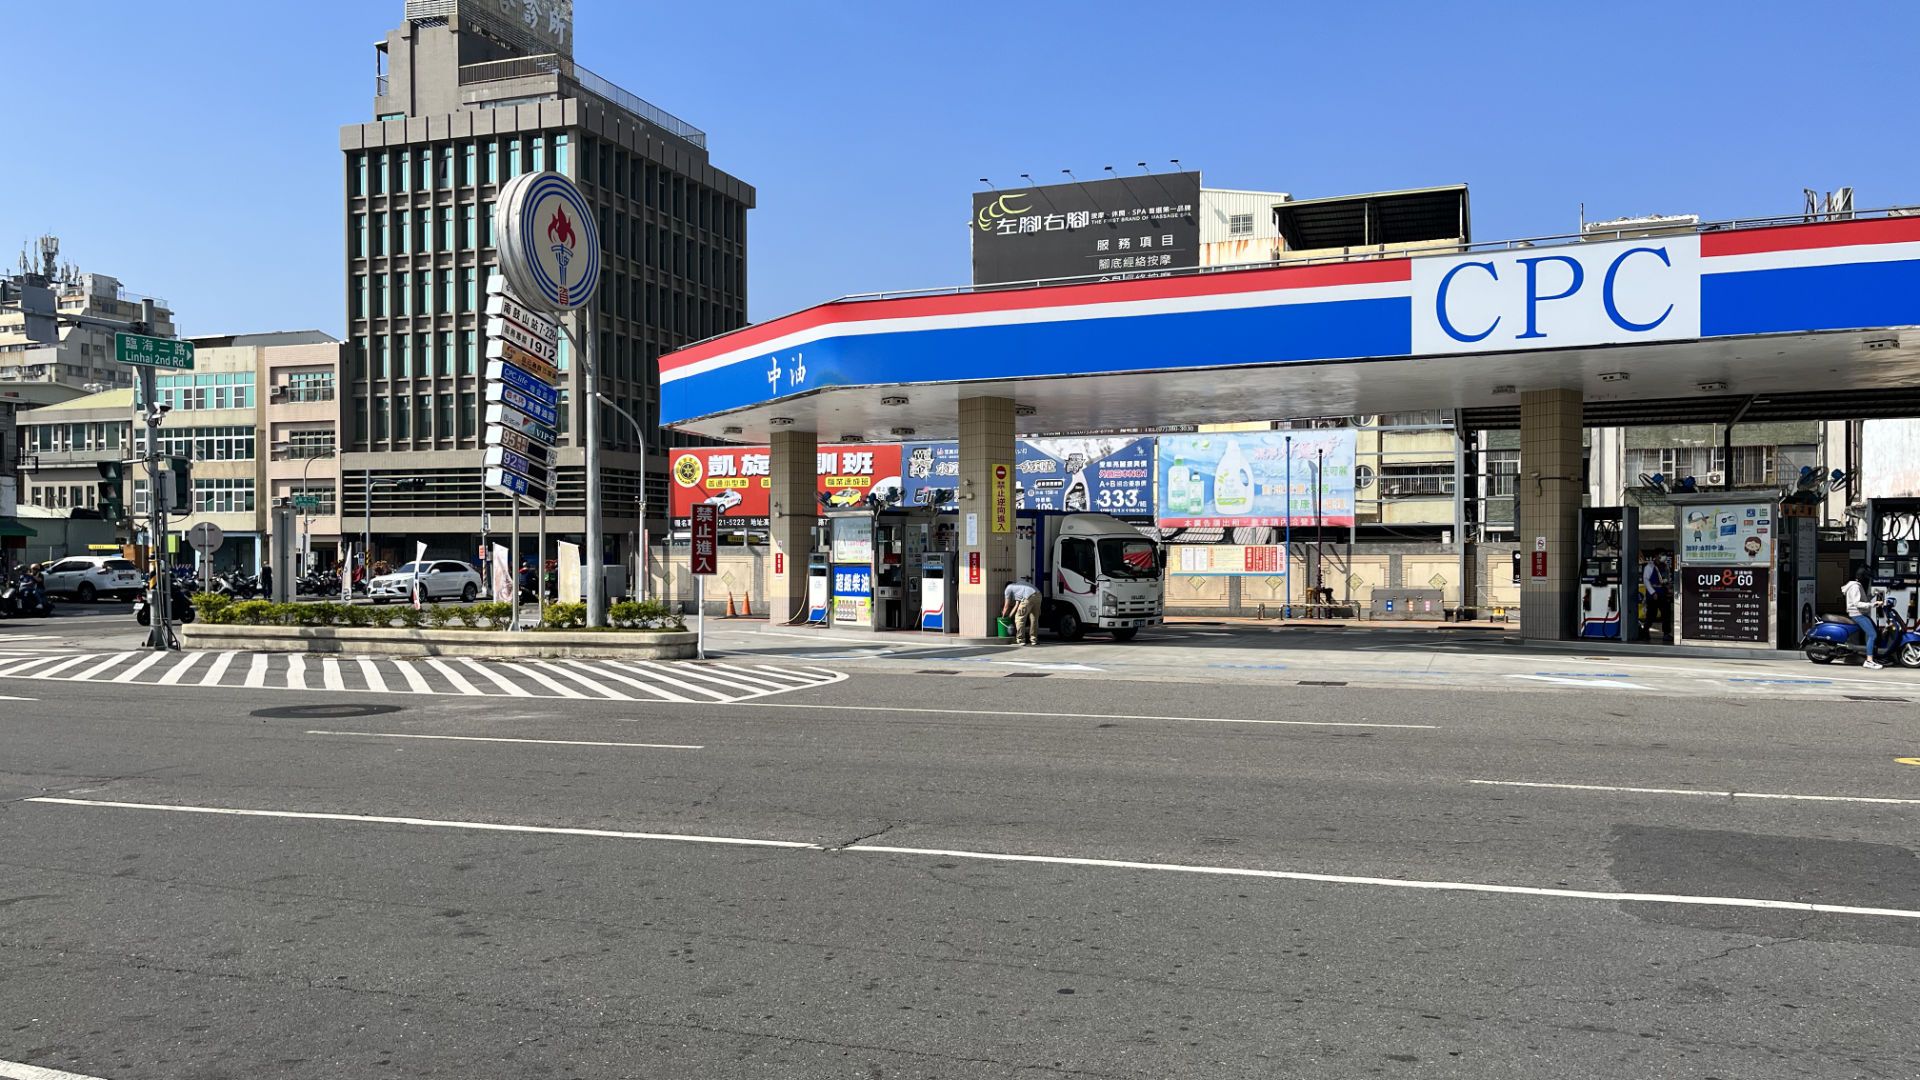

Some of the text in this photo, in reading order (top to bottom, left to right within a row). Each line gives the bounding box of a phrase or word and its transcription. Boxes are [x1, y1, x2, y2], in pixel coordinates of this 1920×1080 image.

[1132, 208, 1147, 216] SPA
[996, 211, 1089, 235] 左腳右腳
[1097, 234, 1173, 251] 服務項目
[1098, 254, 1172, 270] 腳底經絡按摩
[1436, 246, 1674, 342] CPC
[125, 336, 186, 356] 臨海二路
[529, 338, 556, 361] 1912
[125, 351, 187, 368] Linhai 2nd Rd.
[767, 352, 807, 394] 中油
[503, 430, 516, 446] 95
[503, 452, 518, 468] 92
[503, 473, 525, 492] 超柴
[996, 481, 1006, 531] 禁止逆向進入
[1099, 489, 1138, 508] 333
[696, 506, 713, 572] 禁止進入
[835, 573, 870, 593] 超級柴油
[1698, 569, 1753, 586] CUP & GO
